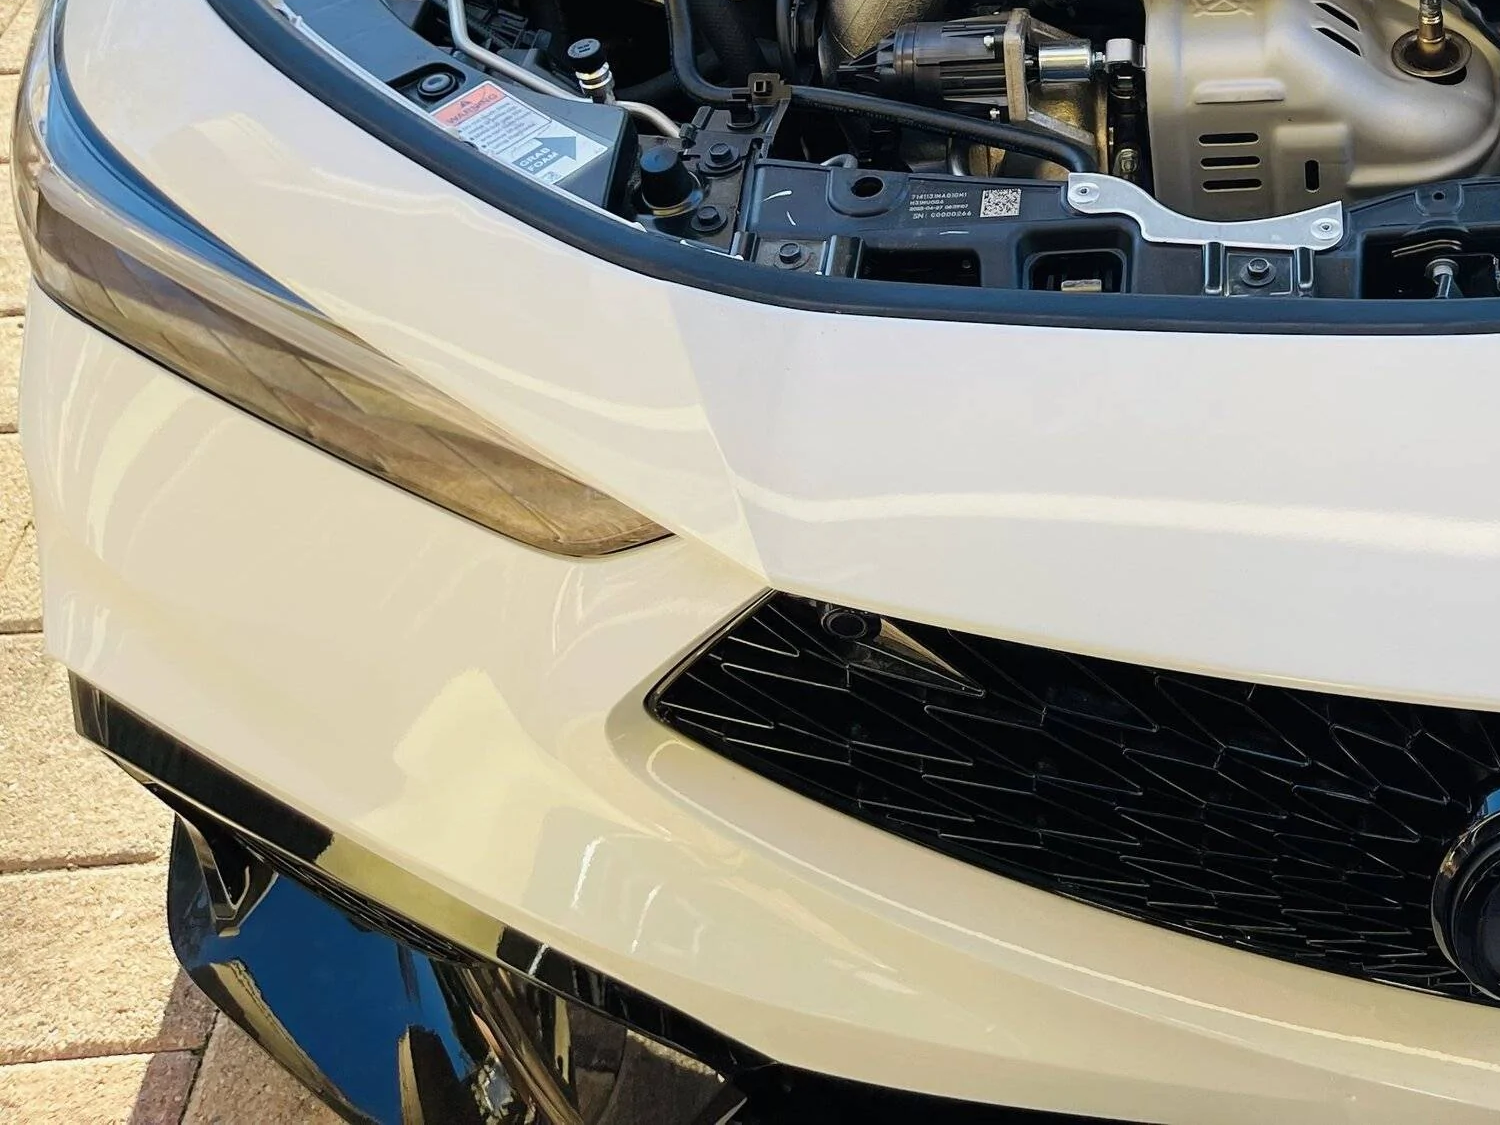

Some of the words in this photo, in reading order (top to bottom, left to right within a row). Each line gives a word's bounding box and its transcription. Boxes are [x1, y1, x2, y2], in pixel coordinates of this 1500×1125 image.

[446, 92, 499, 125] WARNING
[518, 147, 551, 167] GRAB
[527, 152, 560, 173] FOAM
